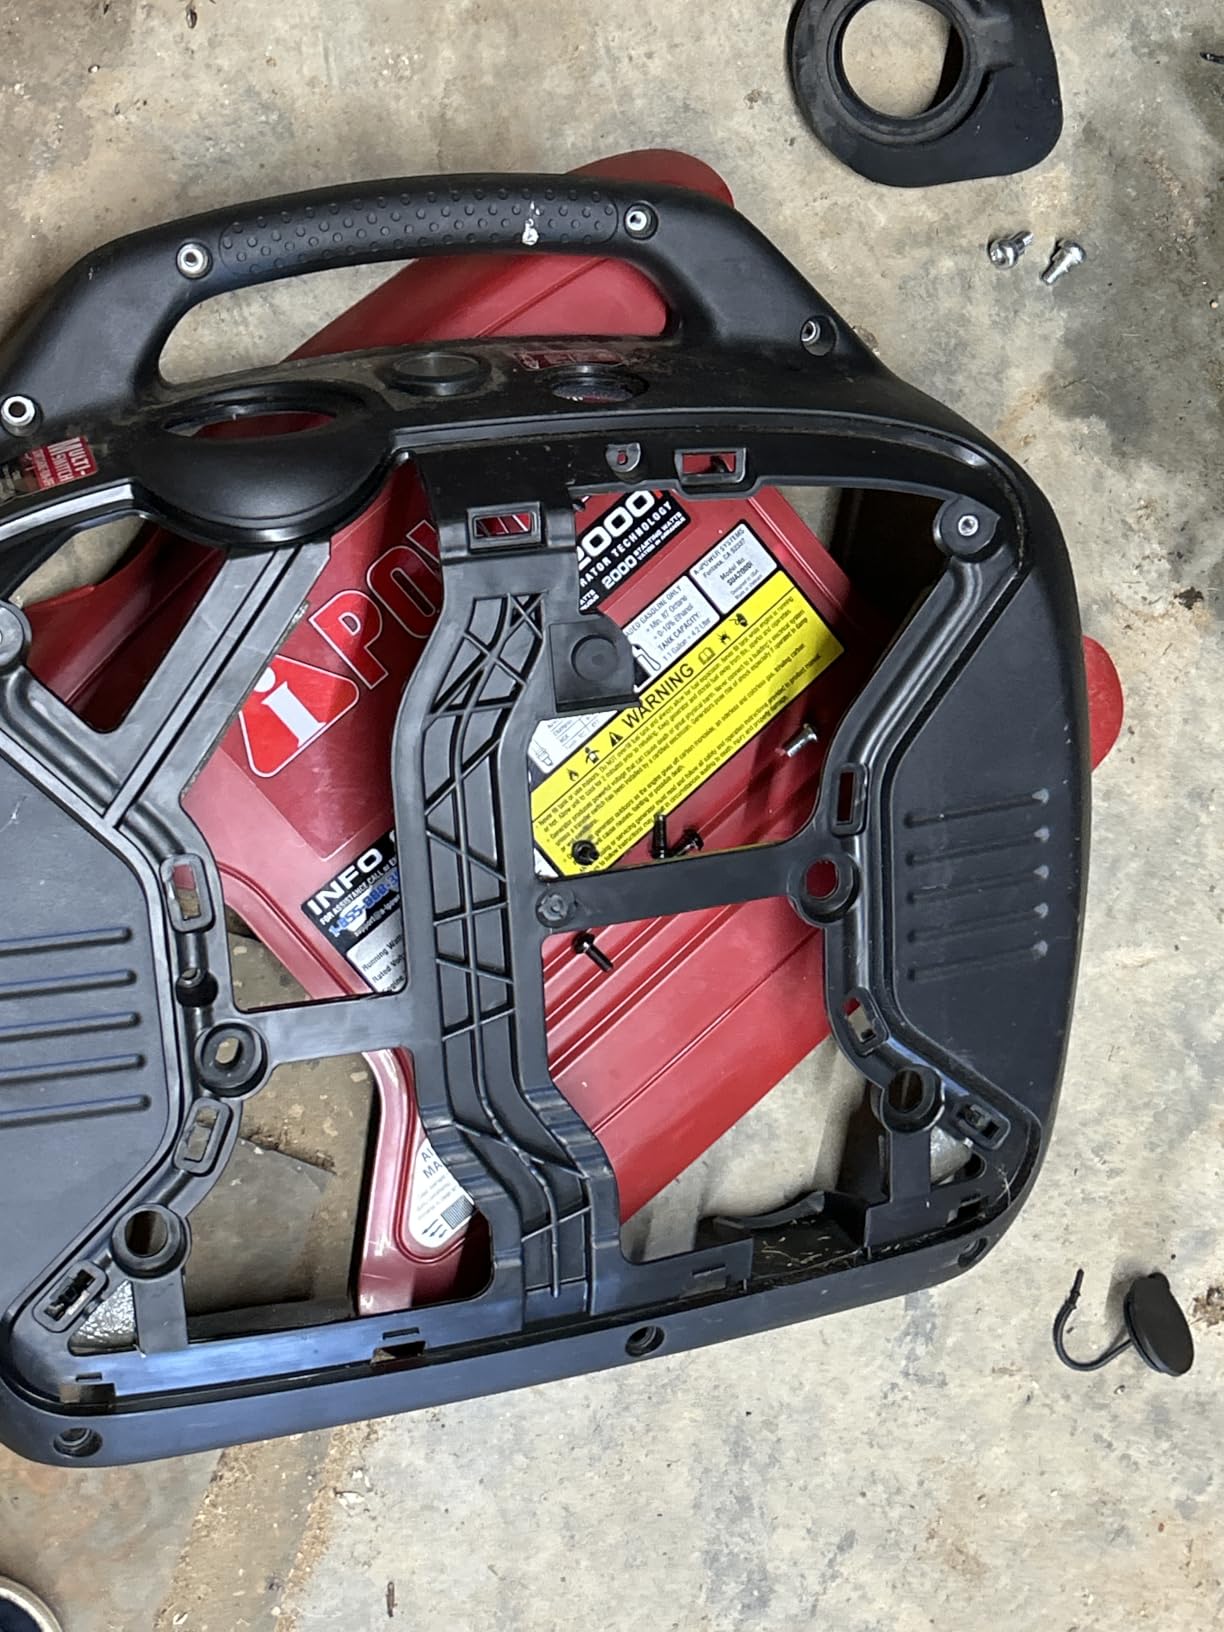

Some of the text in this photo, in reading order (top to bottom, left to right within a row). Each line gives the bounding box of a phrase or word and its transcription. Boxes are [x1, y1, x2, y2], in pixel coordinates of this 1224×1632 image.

[612, 500, 673, 558] TECHNOLOGY
[632, 510, 682, 556] STARTING WATTS
[718, 527, 745, 552] SYSTEMS
[721, 550, 732, 560] CA
[602, 553, 639, 590] 2000
[719, 563, 738, 580] Model
[638, 597, 667, 624] GASOLINE
[665, 584, 682, 600] ONLY
[667, 593, 688, 613] Octane
[672, 602, 694, 622] Ethanol
[657, 634, 674, 651] TANK
[621, 662, 695, 729] WARNING
[307, 847, 384, 916] INFO
[319, 910, 335, 925] FOR
[331, 881, 369, 914] ASSISTANCE
[365, 868, 383, 885] CALL
[361, 947, 389, 972] Running
[371, 964, 392, 983] Rated
